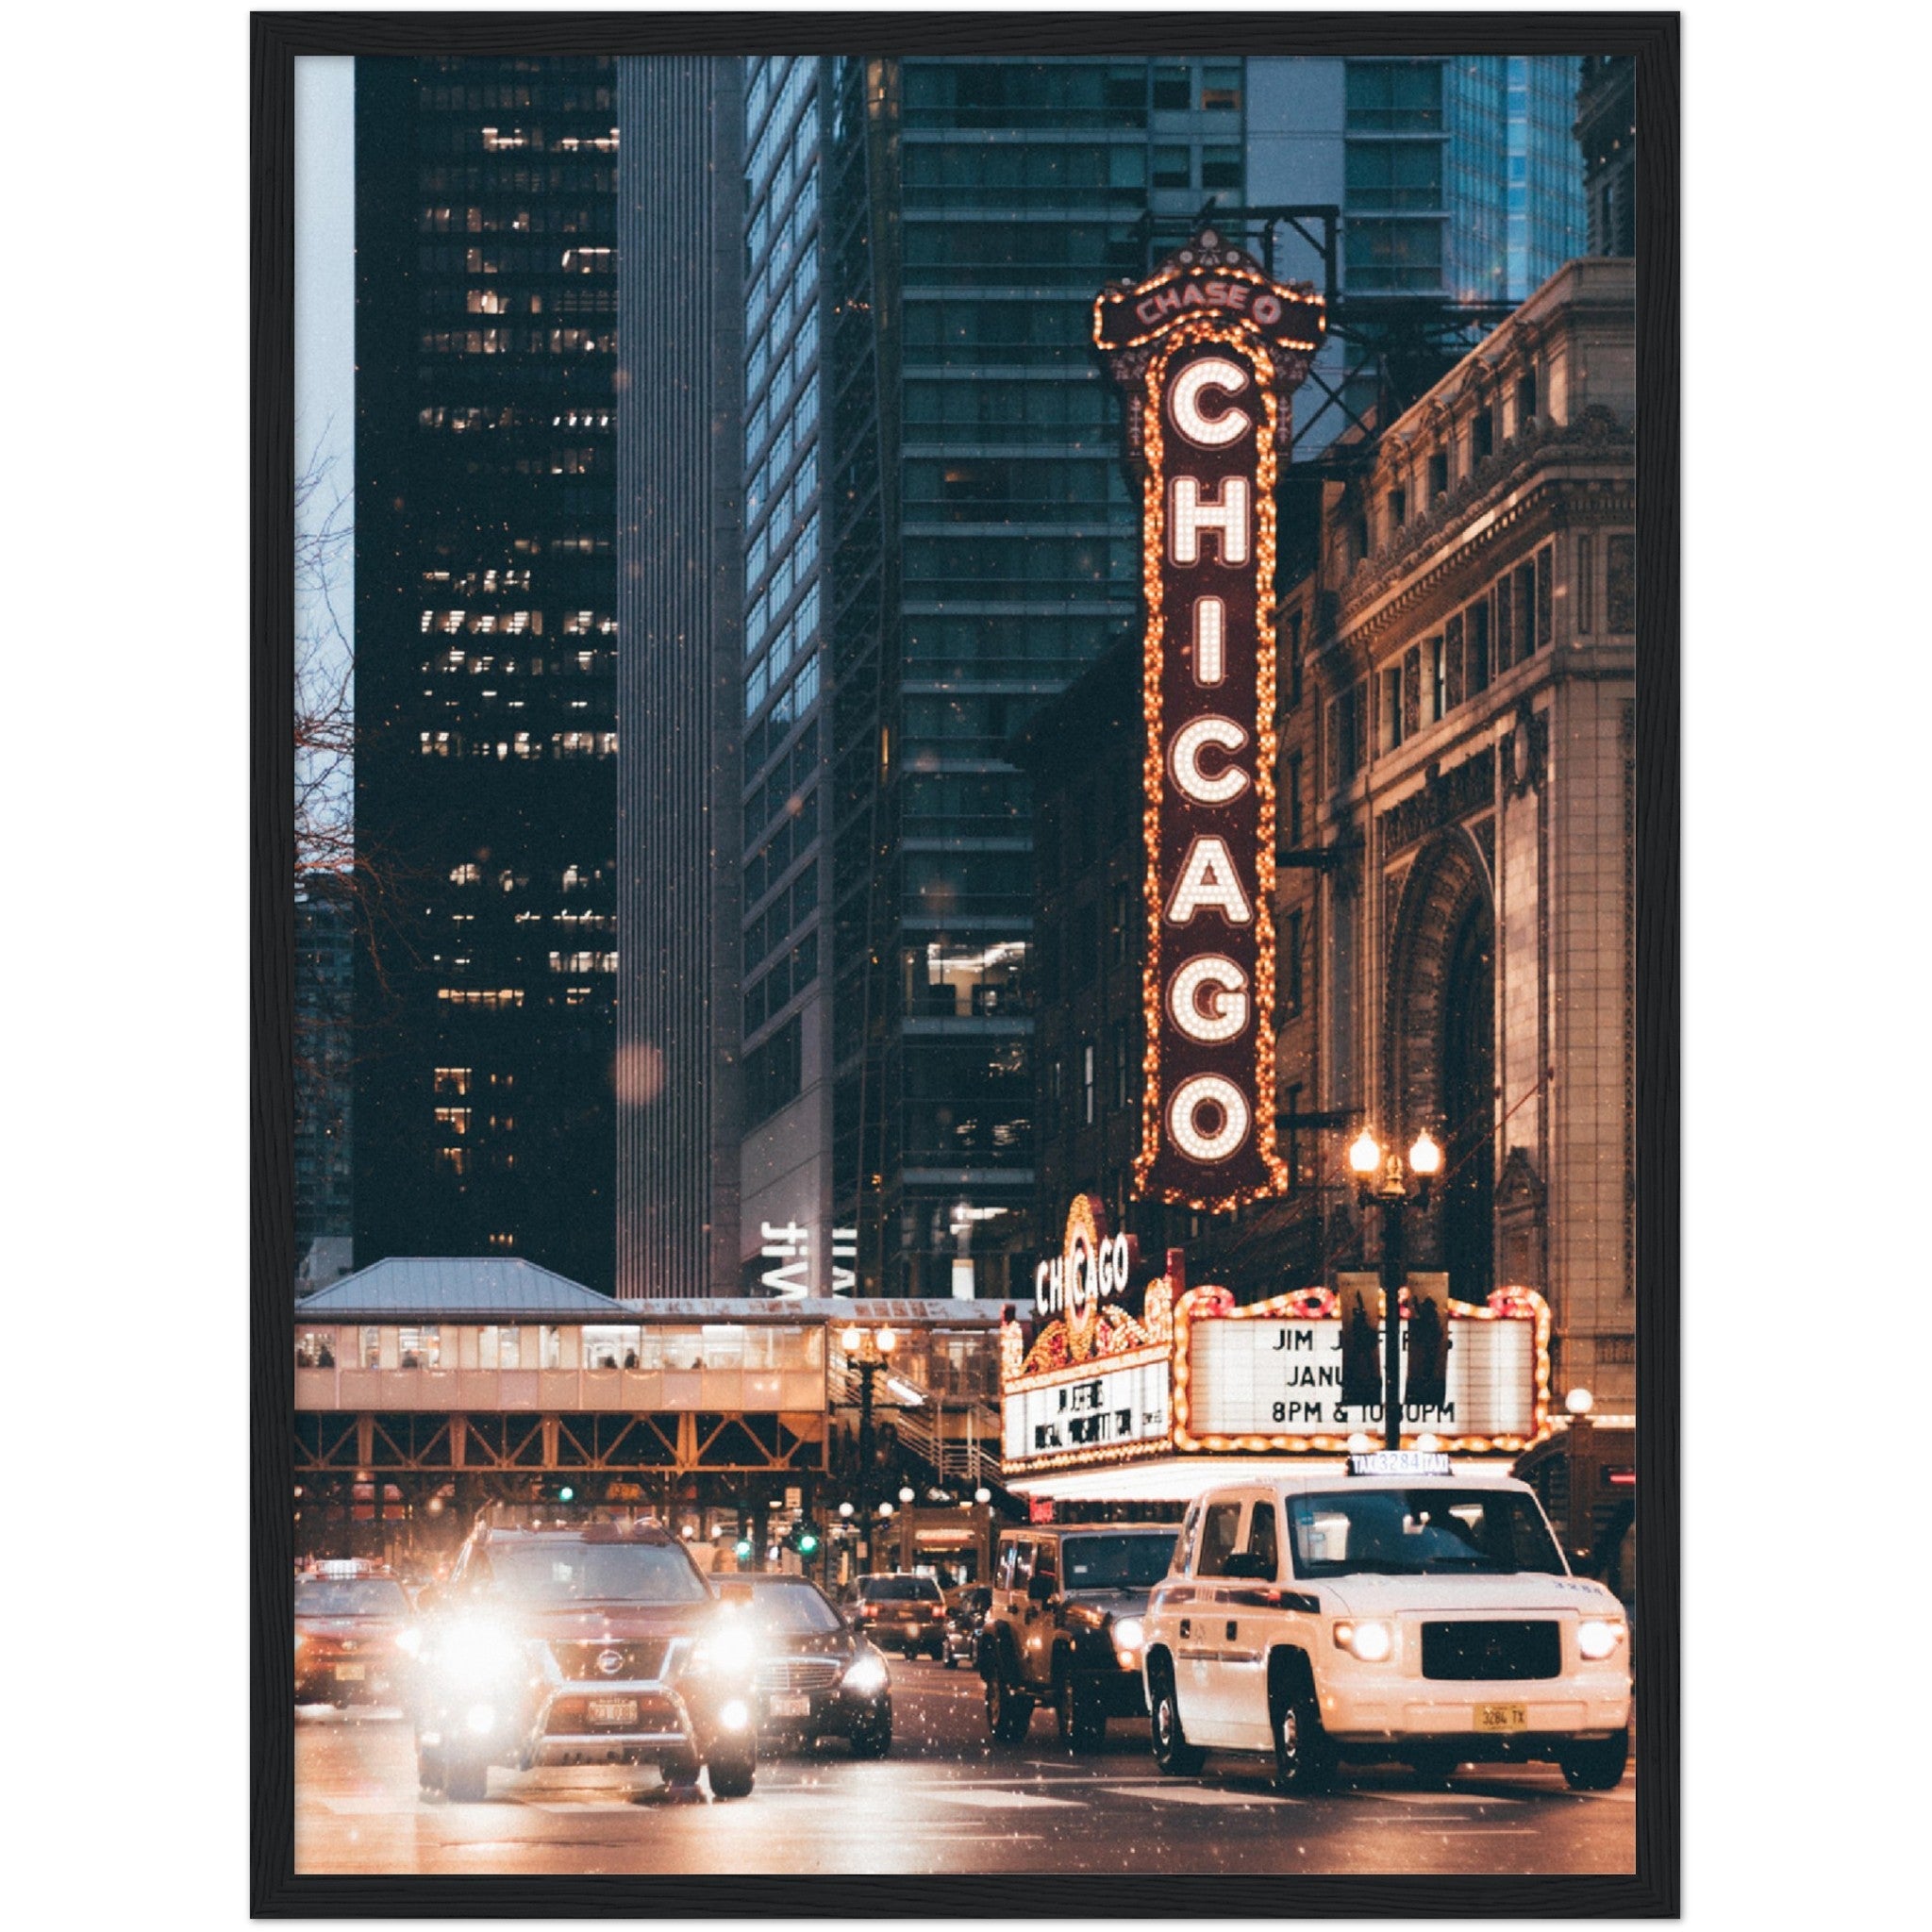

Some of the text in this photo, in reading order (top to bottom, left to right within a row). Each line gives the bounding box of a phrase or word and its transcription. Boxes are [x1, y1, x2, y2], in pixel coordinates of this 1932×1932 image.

[1136, 282, 1251, 325] CHASE
[1168, 357, 1252, 1164] CHICAGO
[1036, 1231, 1128, 1316] CHICAGO
[1273, 1328, 1313, 1351] JIM
[1273, 1402, 1323, 1423] 8PM
[1333, 1402, 1348, 1423] &
[1378, 1453, 1420, 1472] 3284
[1482, 1709, 1525, 1725] 3284 TX
